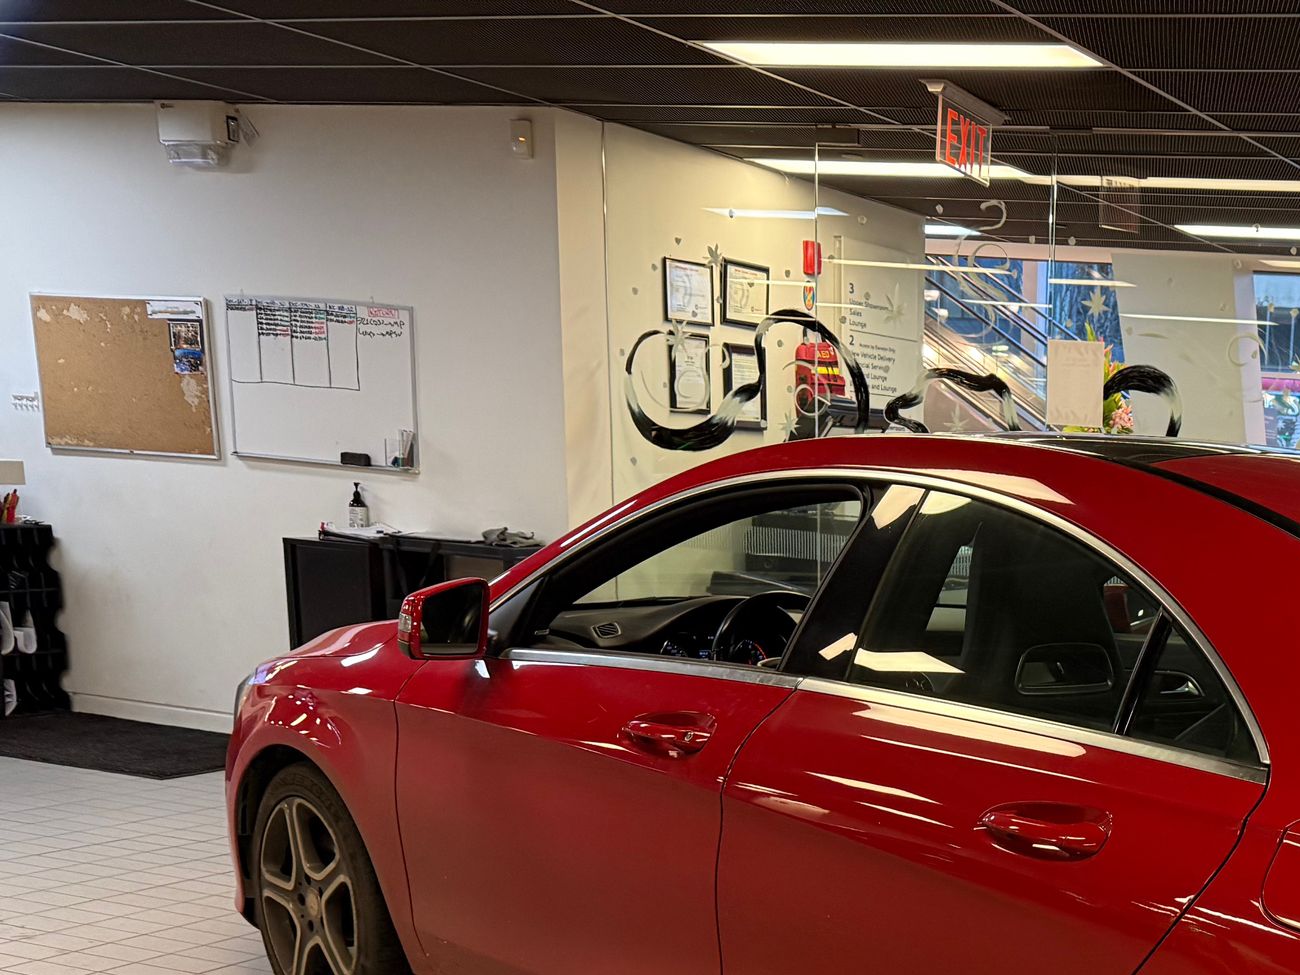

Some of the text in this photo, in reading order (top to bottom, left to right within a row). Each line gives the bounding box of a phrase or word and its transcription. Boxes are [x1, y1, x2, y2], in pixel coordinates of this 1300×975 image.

[945, 108, 987, 176] EXIT
[848, 282, 854, 294] 3
[849, 308, 862, 317] Sales
[849, 319, 867, 329] Lounge
[849, 335, 855, 346] 2
[877, 353, 896, 363] Delivery
[870, 372, 888, 383] Lounge
